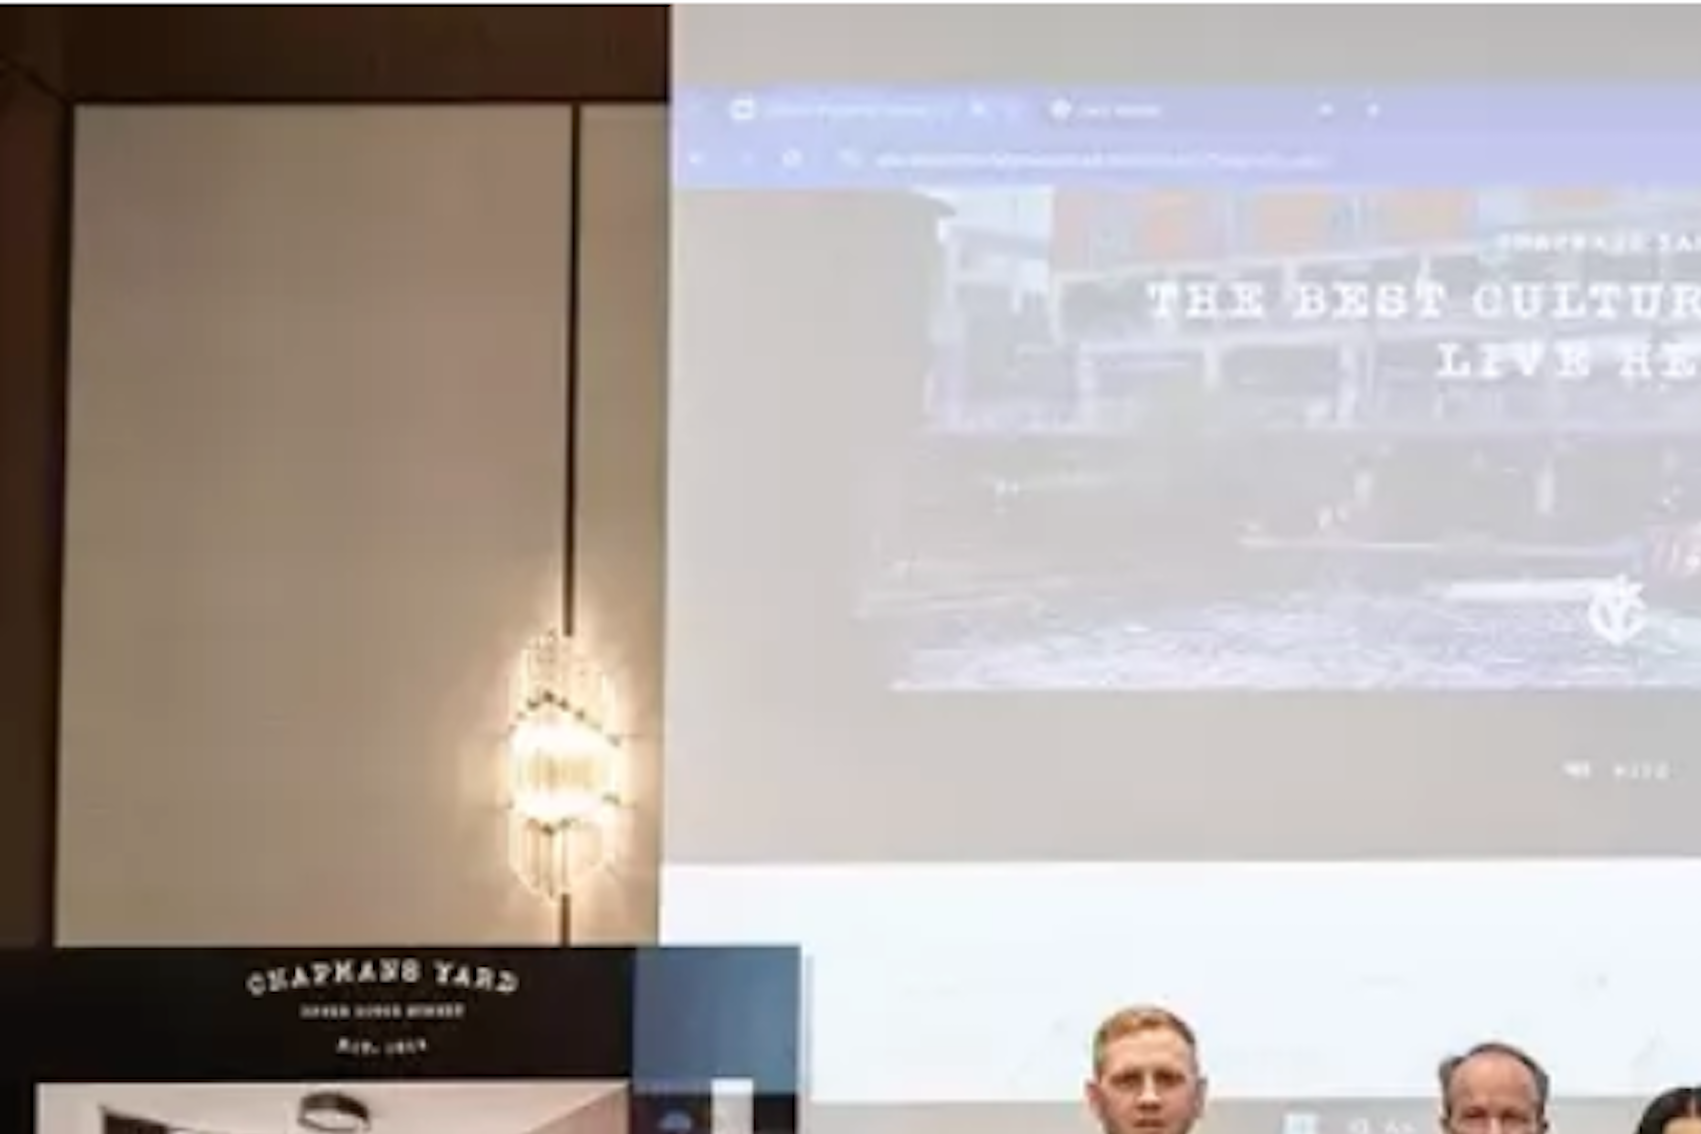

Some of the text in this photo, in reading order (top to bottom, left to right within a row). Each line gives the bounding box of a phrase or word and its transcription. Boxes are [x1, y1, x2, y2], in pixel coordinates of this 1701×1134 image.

[1147, 281, 1267, 319] THE
[1292, 281, 1447, 319] BEST
[1436, 342, 1591, 378] LIVE
[245, 957, 520, 997] CHAPMANS YARD
